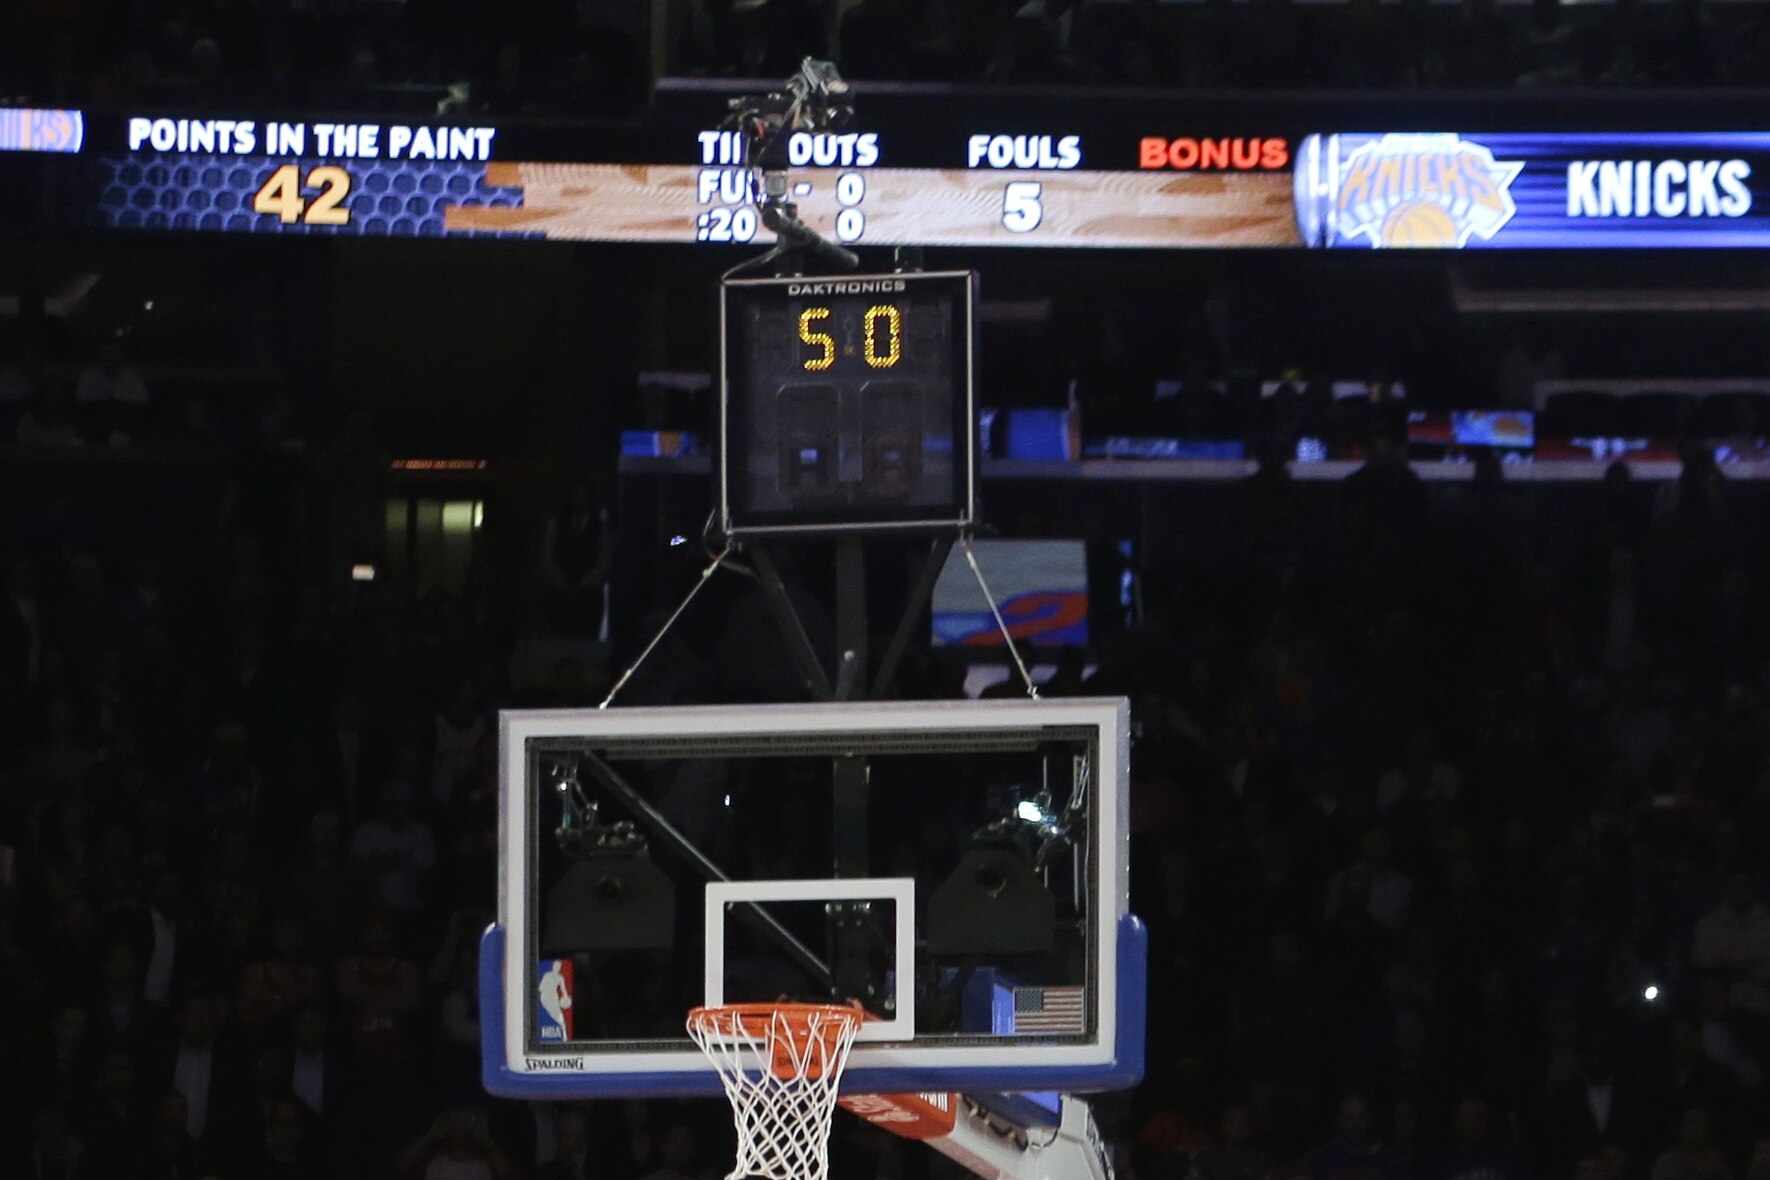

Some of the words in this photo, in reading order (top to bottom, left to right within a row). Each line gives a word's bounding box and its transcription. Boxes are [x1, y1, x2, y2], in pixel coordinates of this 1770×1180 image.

[128, 117, 256, 154] POINTS
[265, 122, 306, 156] IN
[313, 123, 381, 158] THE
[388, 125, 496, 161] PAINT
[968, 134, 1082, 168] FOULS
[1140, 137, 1289, 169] BONUS
[254, 165, 350, 224] 42
[836, 172, 866, 208] 0
[1566, 158, 1753, 218] KNICKS
[697, 207, 758, 243] :20
[836, 208, 866, 243] 0
[1002, 182, 1044, 232] 5
[788, 280, 905, 296] DAKTRONICS
[525, 1057, 584, 1072] SPALDING
